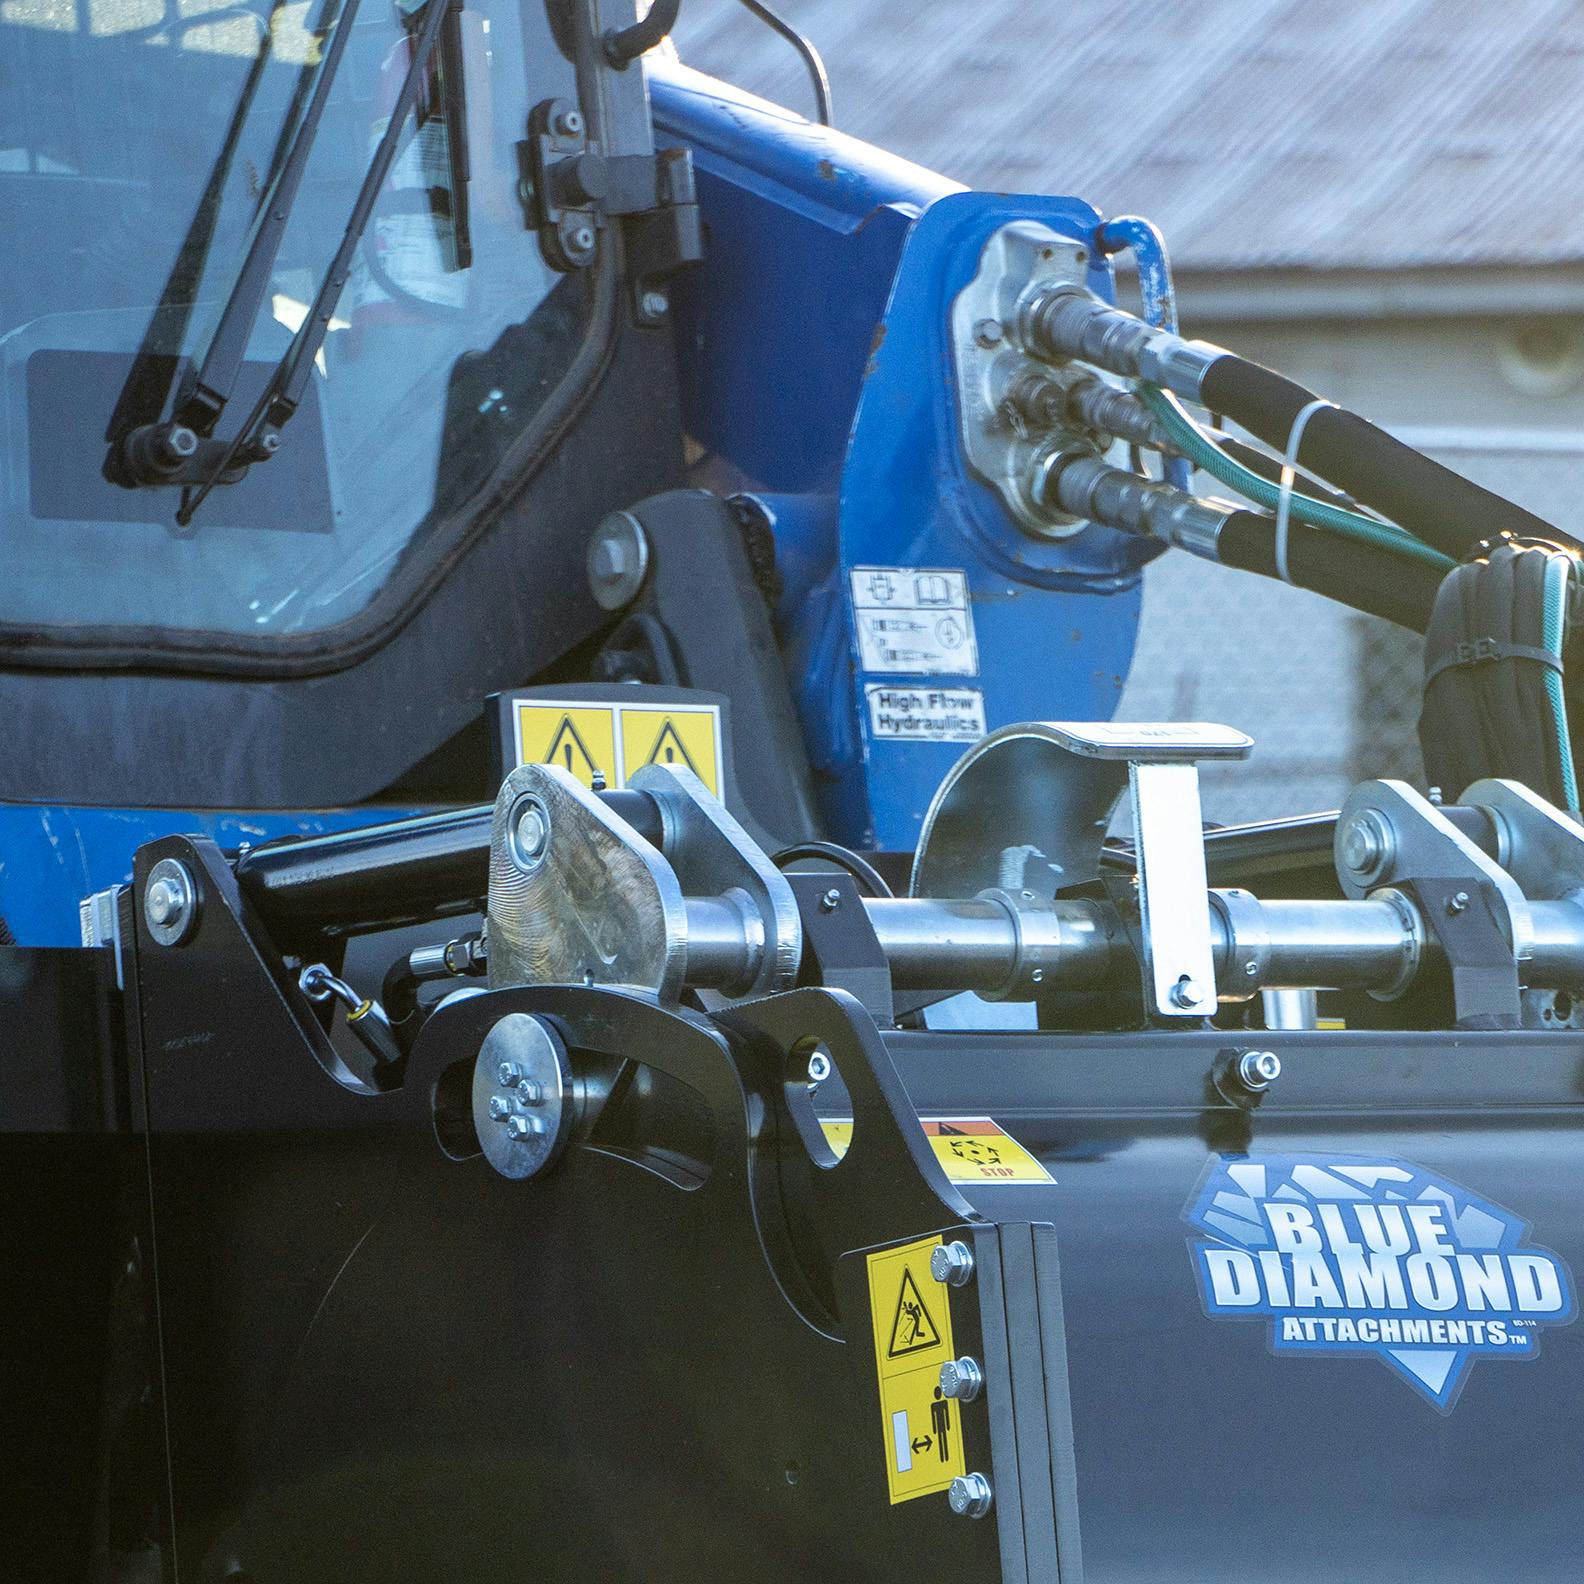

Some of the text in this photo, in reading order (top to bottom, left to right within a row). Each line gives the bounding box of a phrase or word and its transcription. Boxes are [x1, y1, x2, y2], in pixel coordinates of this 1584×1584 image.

[878, 692, 974, 712] High Flow
[878, 714, 980, 733] Hydraulics
[980, 1168, 1014, 1177] STOP
[1264, 1203, 1456, 1256] BLUE
[1205, 1249, 1563, 1312] DIAMOND
[1282, 1317, 1508, 1345] ATTACHMENTS
